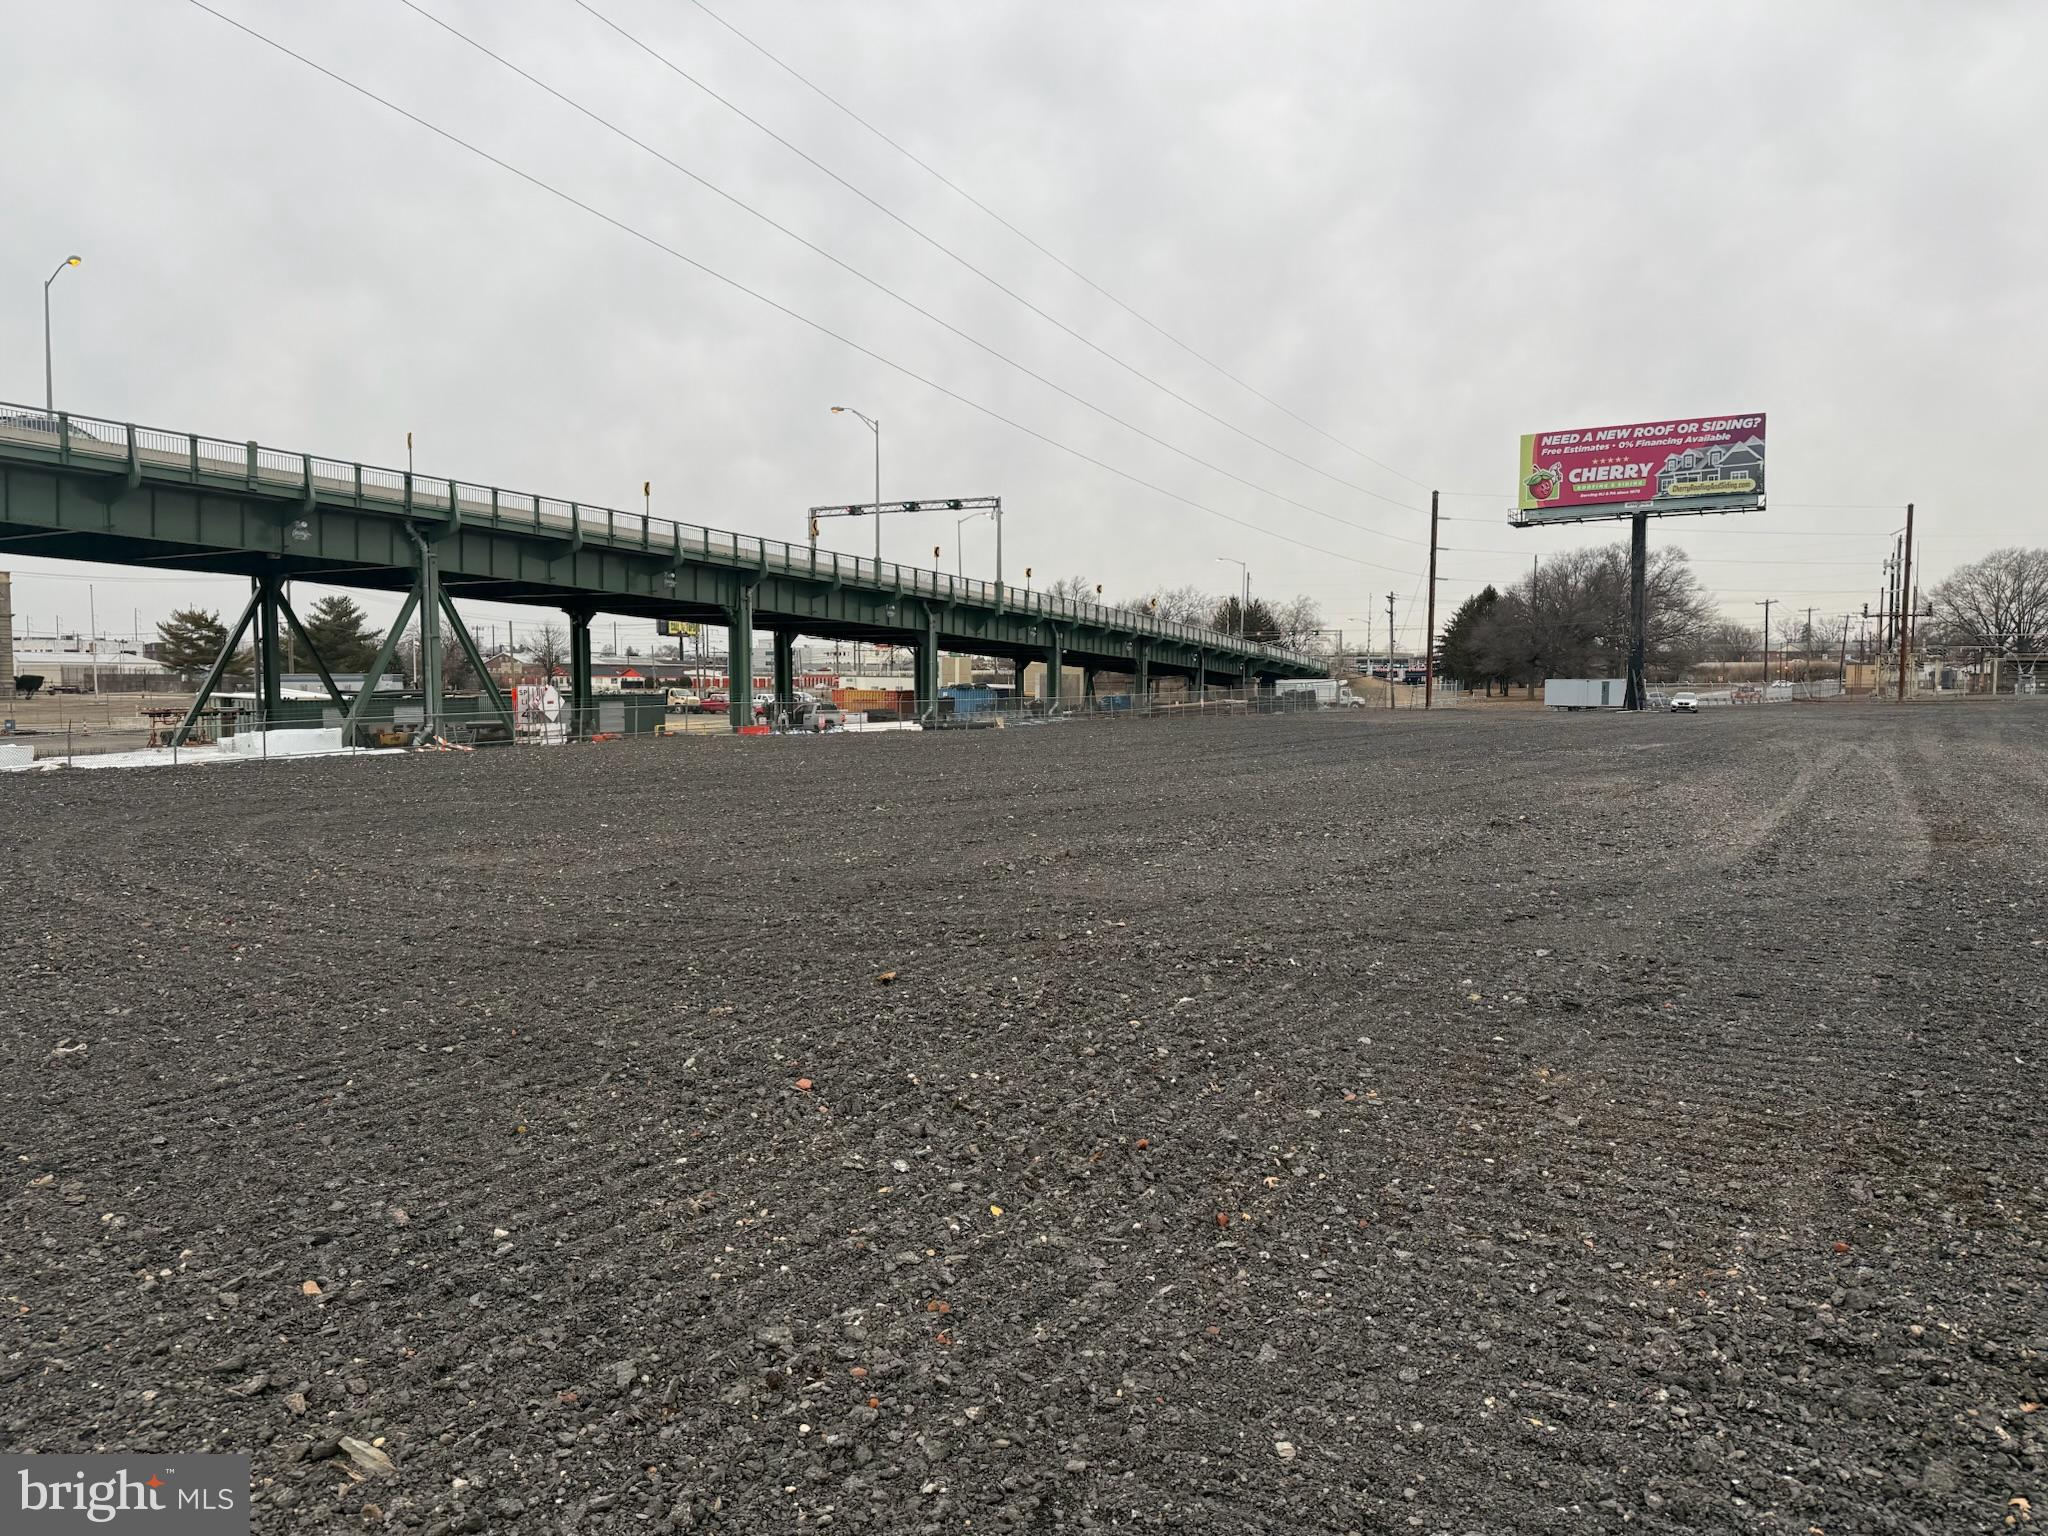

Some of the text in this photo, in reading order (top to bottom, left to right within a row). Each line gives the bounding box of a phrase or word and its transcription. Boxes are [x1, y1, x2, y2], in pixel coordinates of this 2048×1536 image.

[1541, 417, 1762, 447] NEED A NEW ROOF OR SIDING?
[1541, 433, 1731, 456] Free Estimates 0% Financing Available
[1568, 462, 1654, 483] CHERRY
